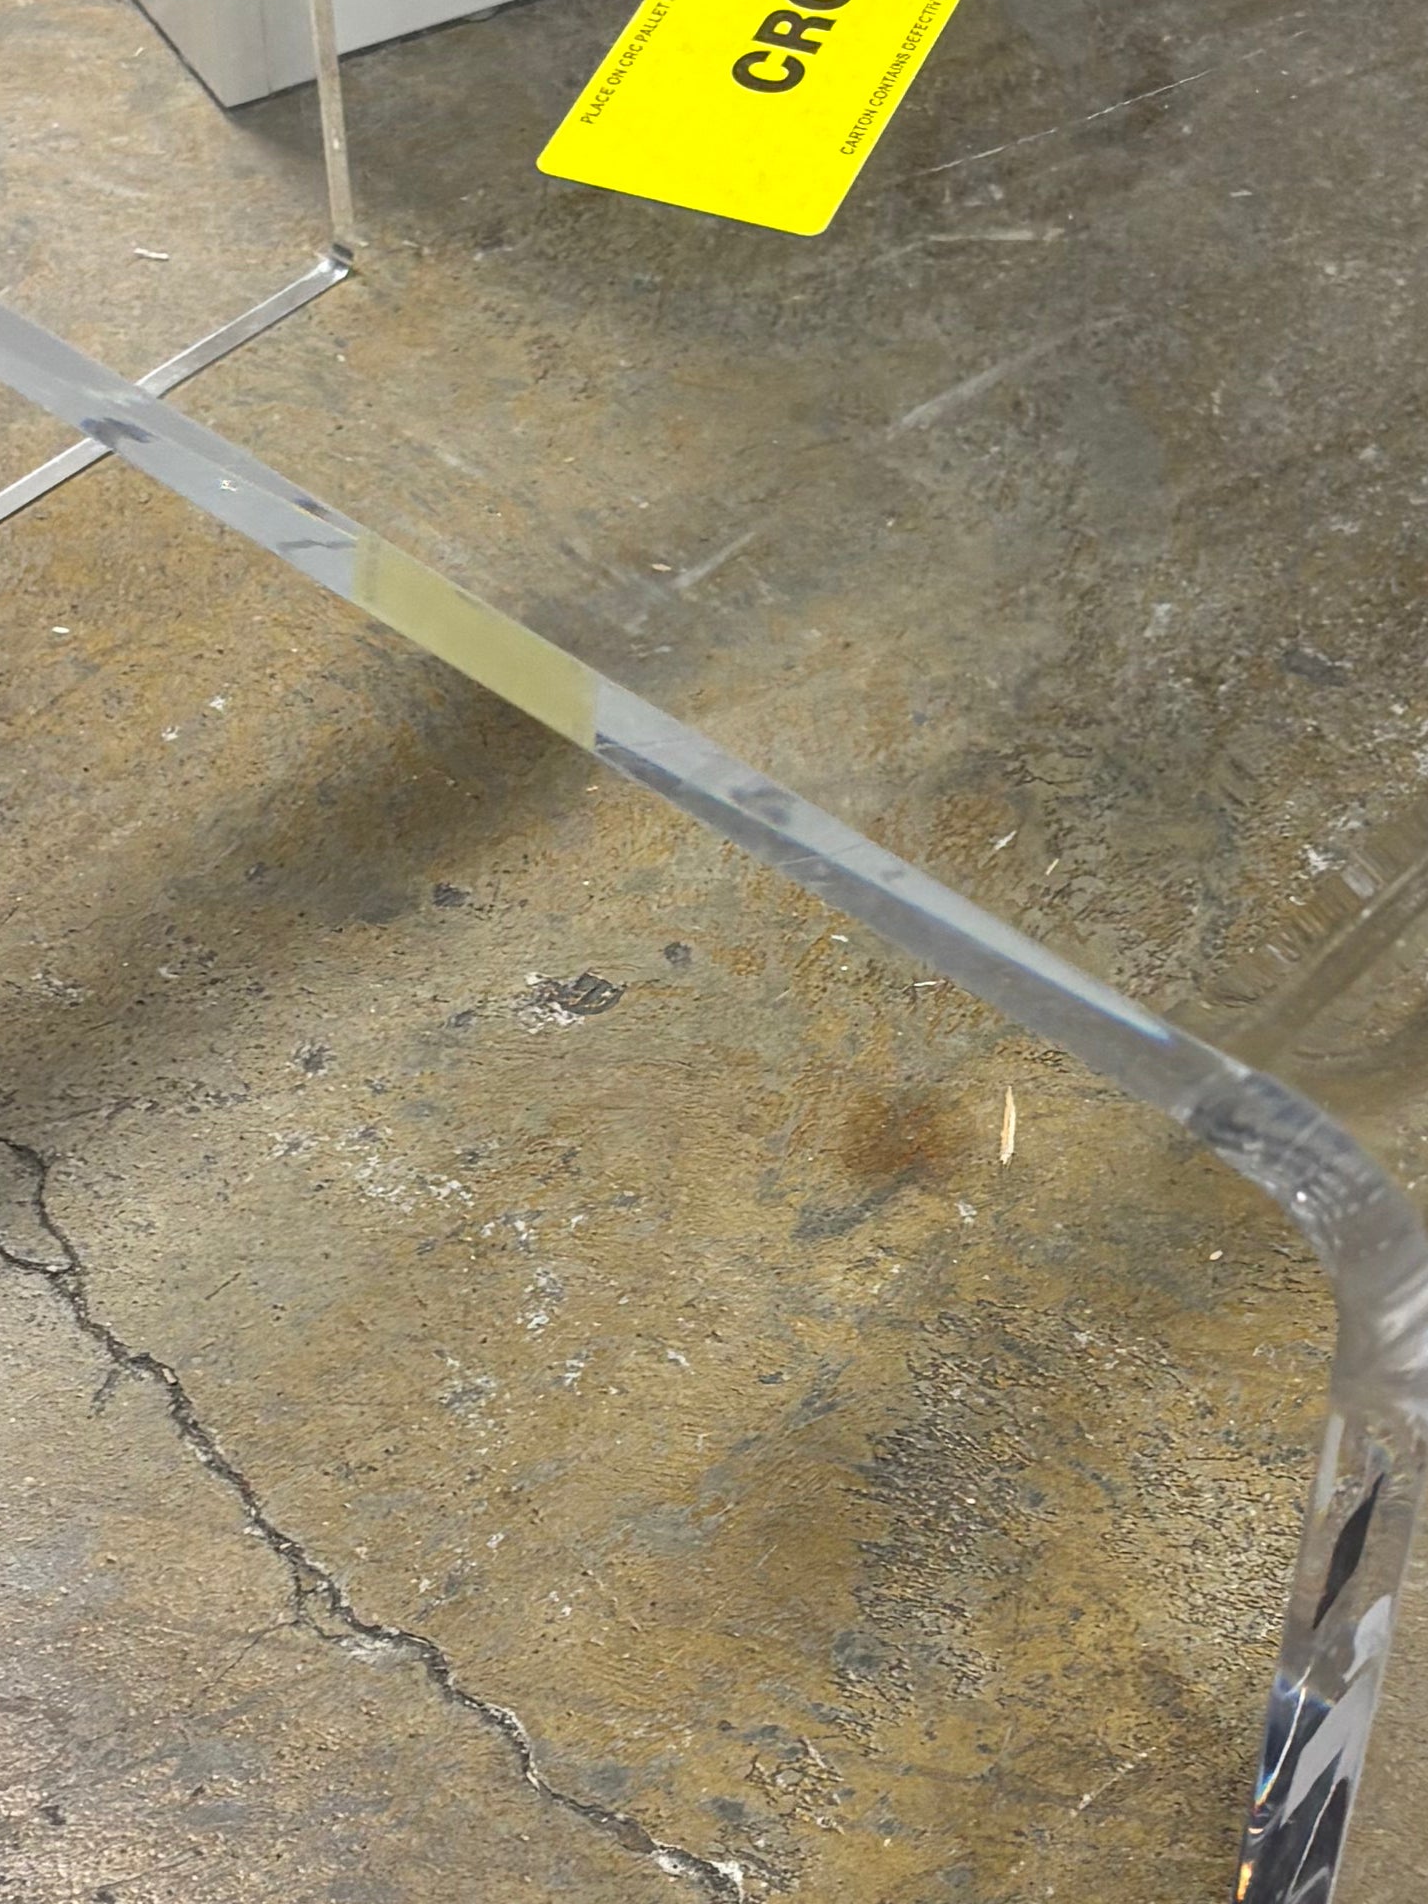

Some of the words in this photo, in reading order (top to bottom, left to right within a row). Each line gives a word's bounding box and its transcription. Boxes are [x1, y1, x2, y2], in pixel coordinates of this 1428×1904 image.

[580, 86, 616, 124] PLACE
[606, 68, 628, 86] ON
[618, 43, 644, 67] CRC
[634, 1, 671, 42] PALLET
[839, 108, 879, 156] CARTON
[868, 52, 912, 107] CONTAINS
